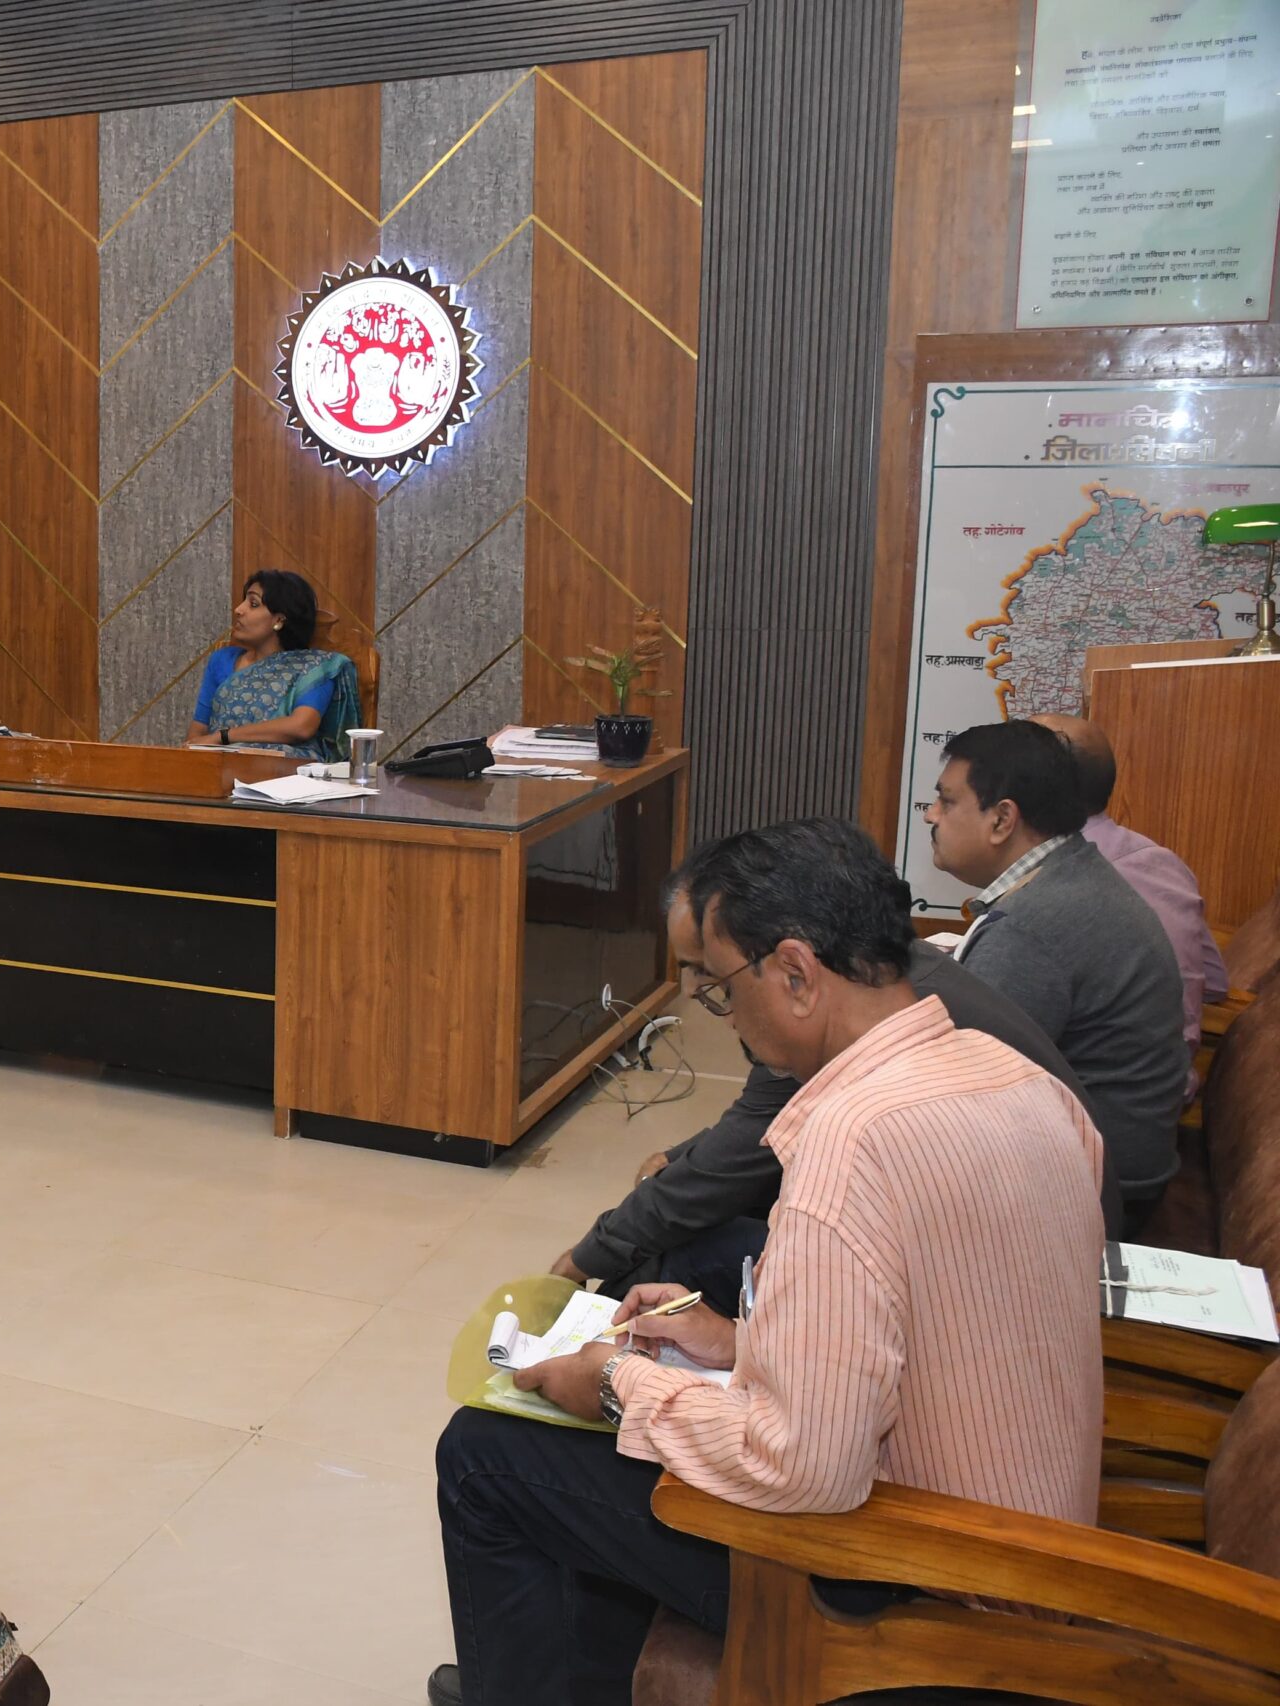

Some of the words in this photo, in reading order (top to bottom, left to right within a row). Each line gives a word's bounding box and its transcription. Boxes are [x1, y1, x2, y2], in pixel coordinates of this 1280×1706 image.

[1040, 434, 1113, 461] जिला
[1125, 434, 1217, 462] सिवनी
[984, 523, 1026, 536] गोटेगांव
